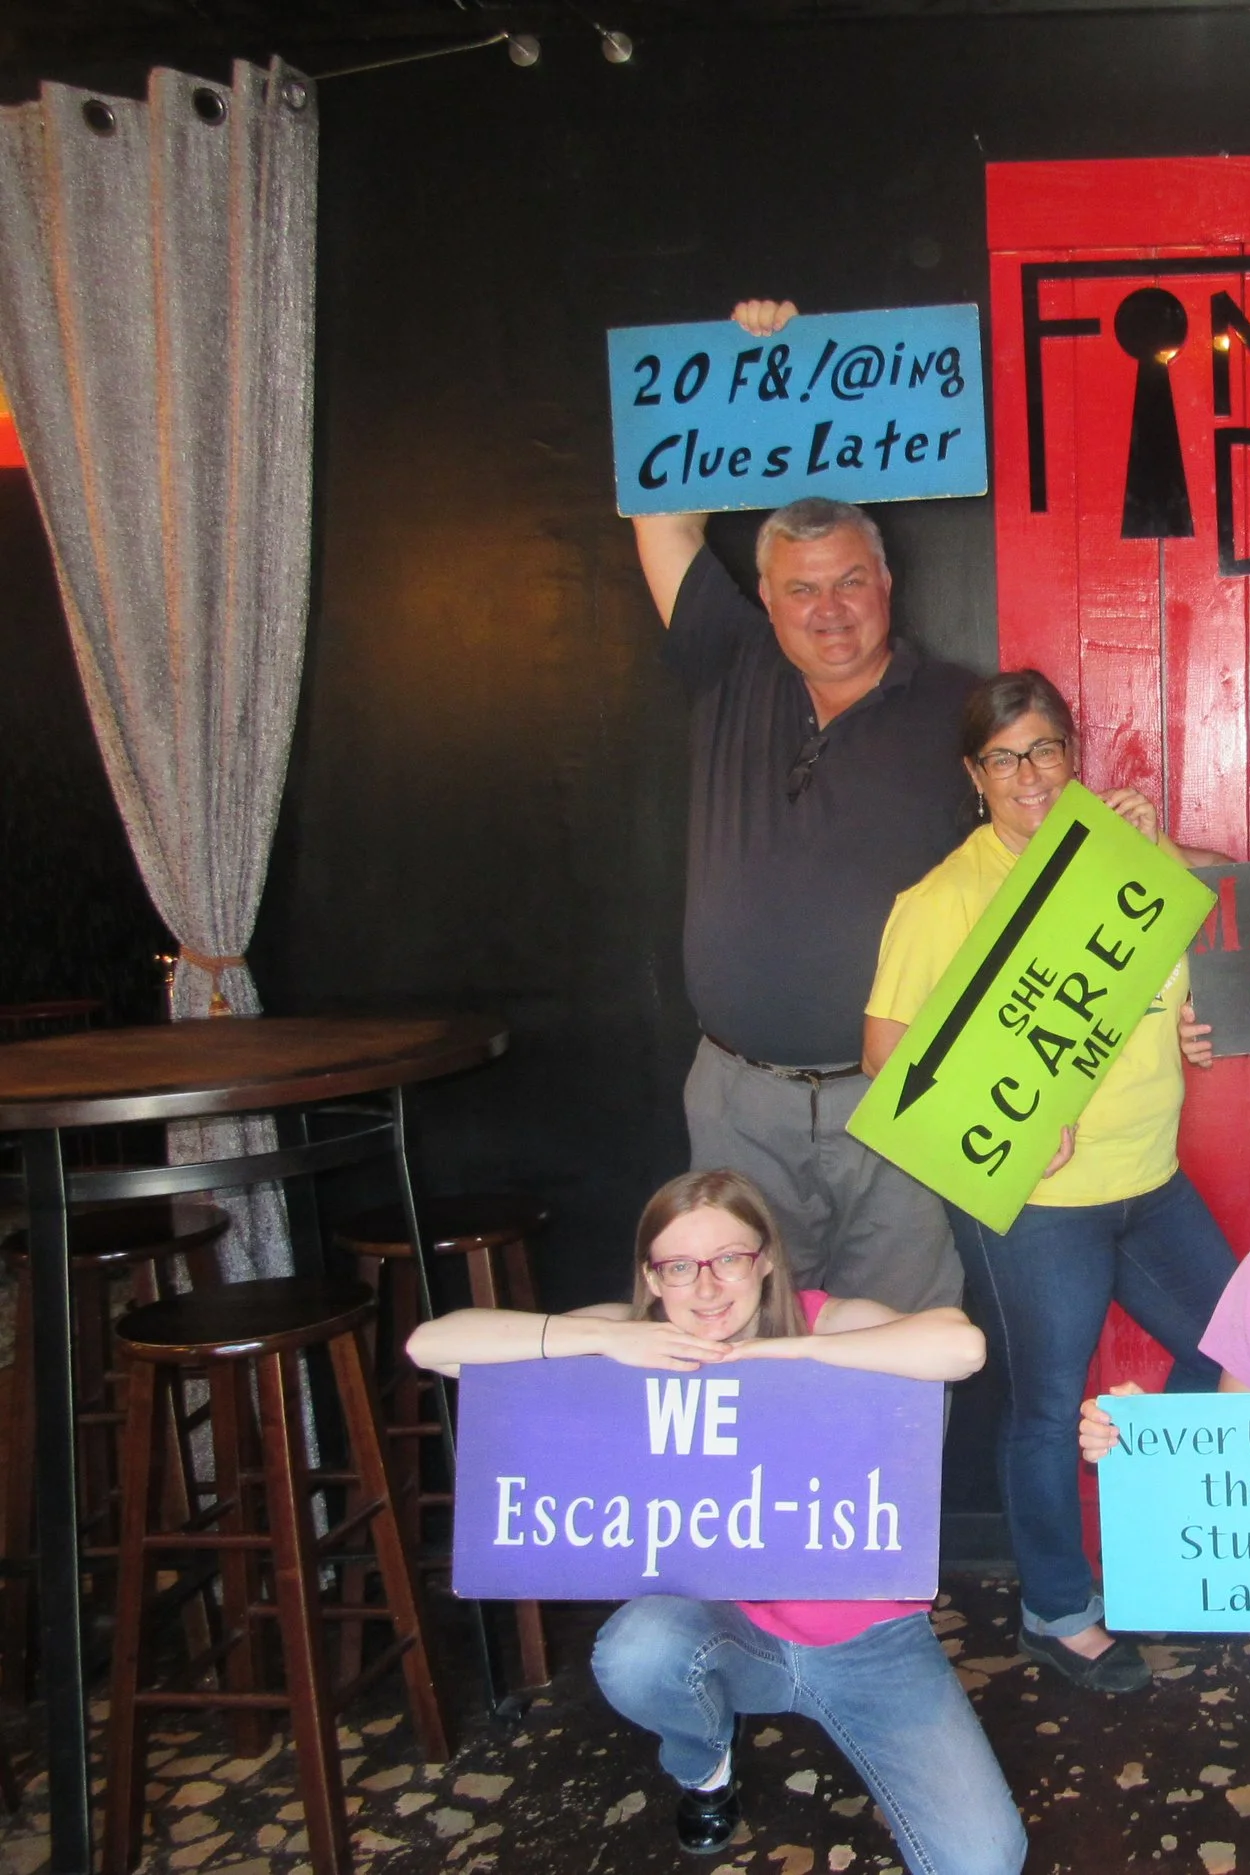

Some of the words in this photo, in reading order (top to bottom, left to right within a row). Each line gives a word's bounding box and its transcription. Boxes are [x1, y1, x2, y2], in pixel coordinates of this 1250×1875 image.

[633, 352, 710, 406] 20
[638, 429, 793, 490] Clues
[806, 419, 961, 476] Later
[960, 880, 1165, 1177] SCARES
[998, 957, 1059, 1037] SHE
[1071, 1018, 1123, 1080] ME
[646, 1378, 740, 1456] WE
[1109, 1421, 1237, 1456] Never
[493, 1464, 903, 1577] Escaped-ish
